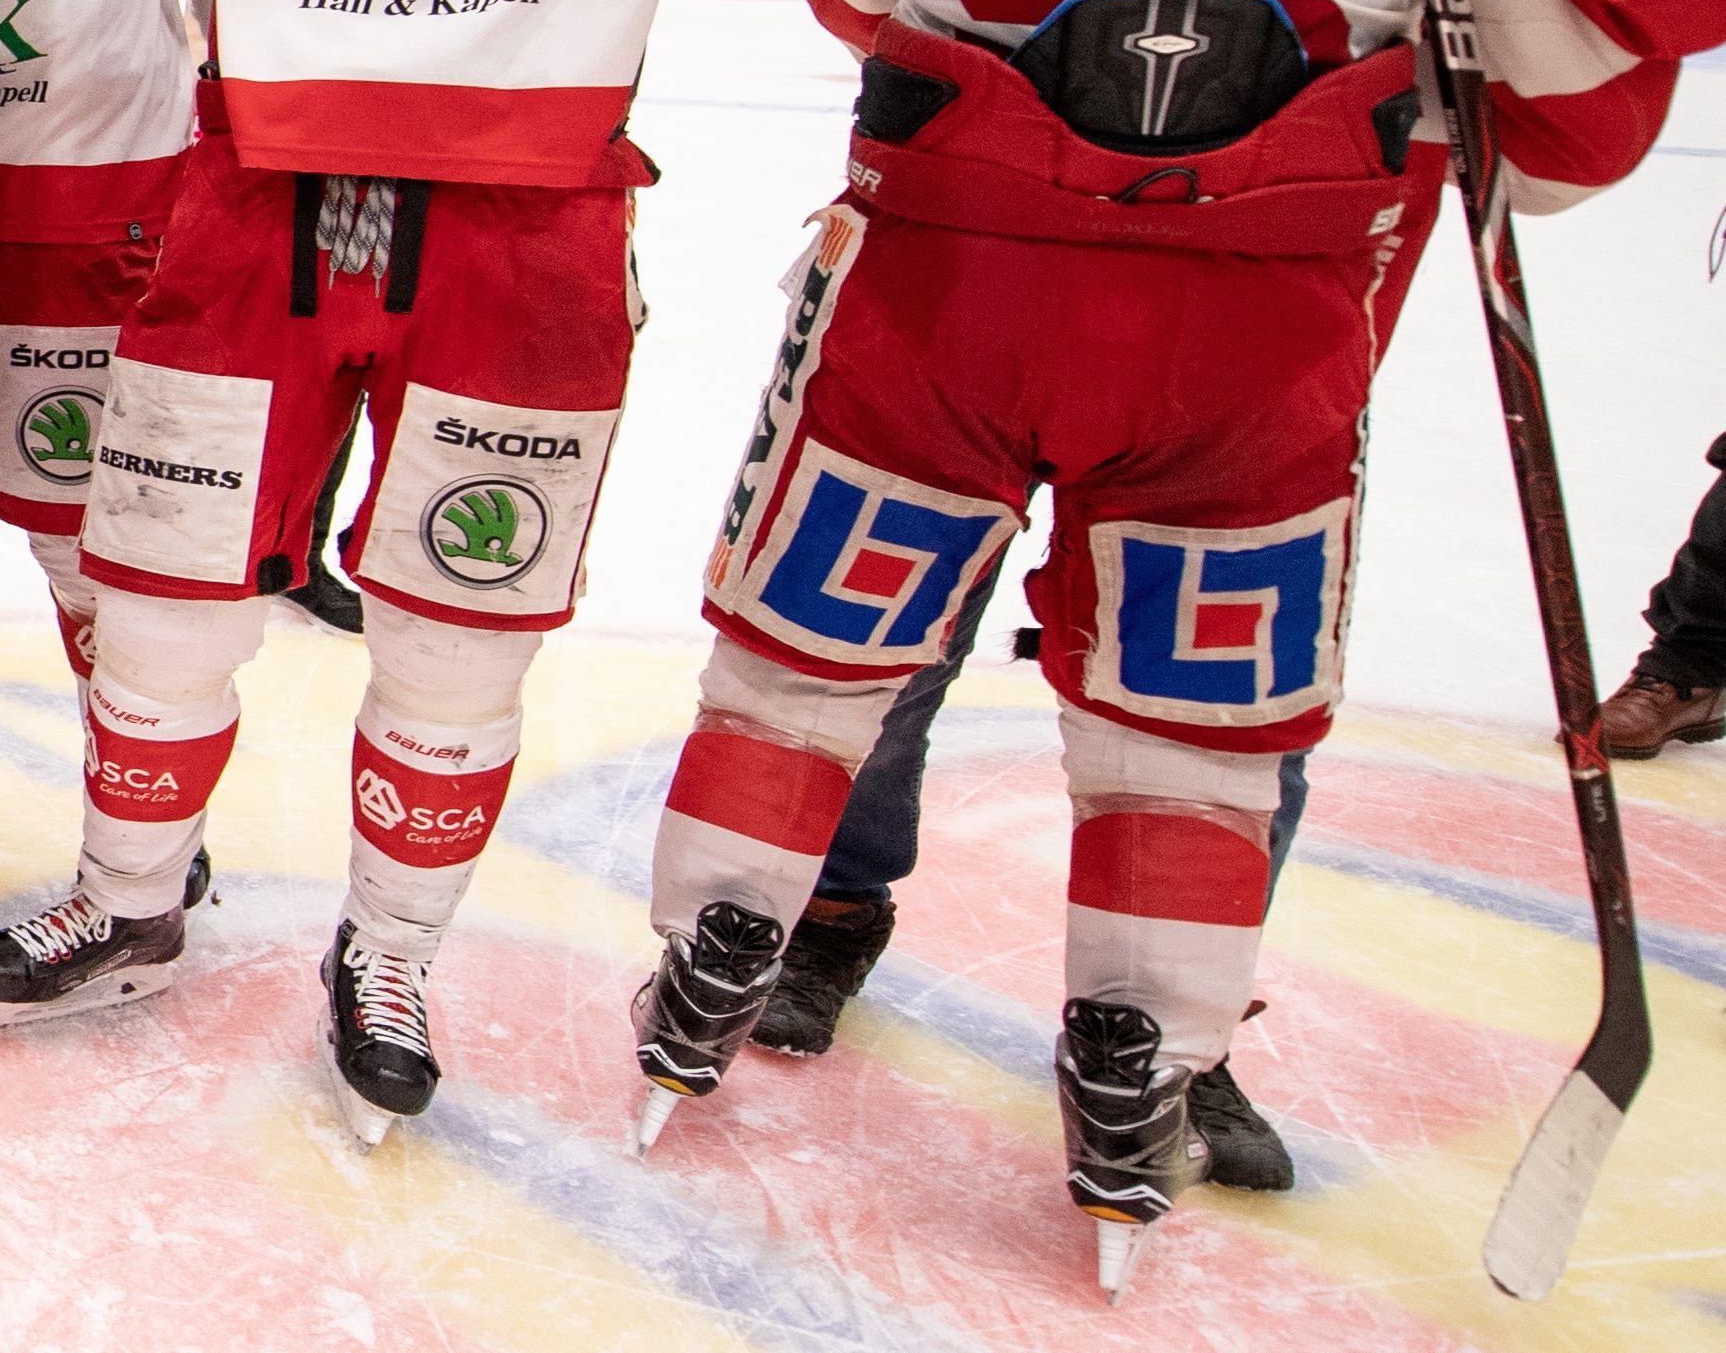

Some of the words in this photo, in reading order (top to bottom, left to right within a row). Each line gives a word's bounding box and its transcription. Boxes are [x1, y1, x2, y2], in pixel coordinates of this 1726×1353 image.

[9, 345, 110, 368] ŠKOD
[433, 417, 583, 460] ŠKODA
[99, 445, 243, 490] BERNERS
[101, 759, 179, 791] SCA
[410, 803, 486, 830] SCA
